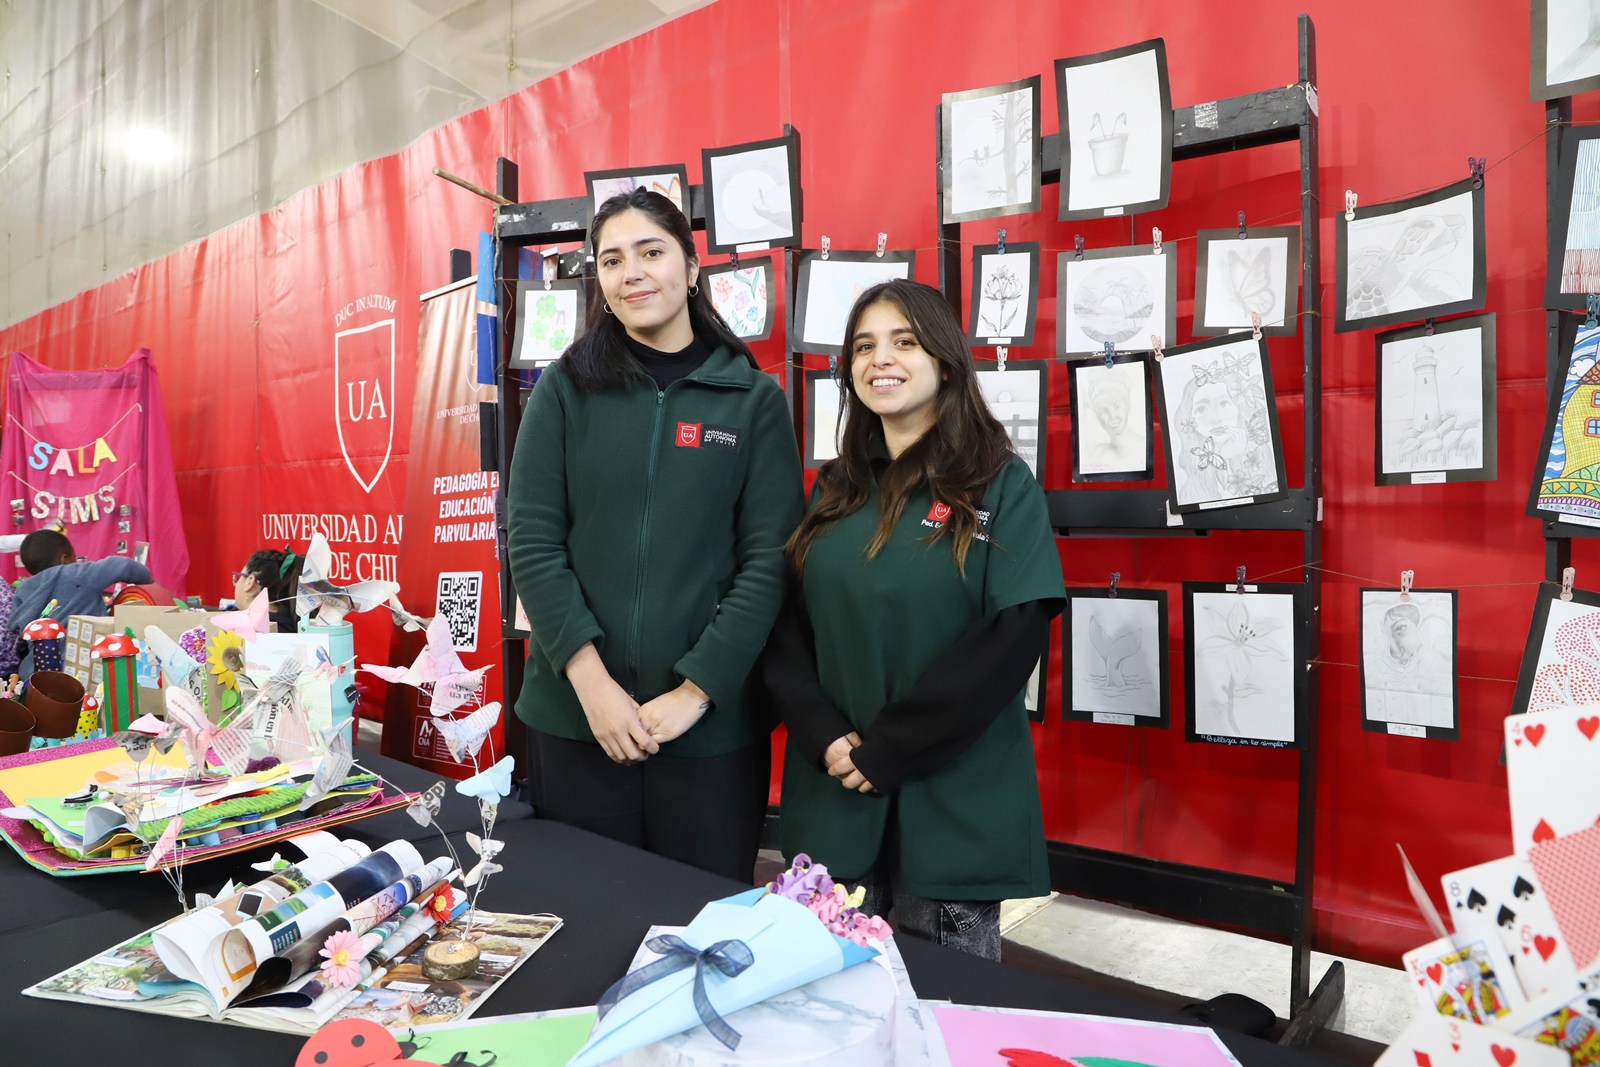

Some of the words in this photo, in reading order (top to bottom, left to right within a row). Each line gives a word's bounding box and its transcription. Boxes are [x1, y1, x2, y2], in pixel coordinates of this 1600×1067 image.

[335, 302, 354, 328] DUC
[366, 294, 397, 313] ALTUM
[346, 378, 388, 422] UA
[437, 403, 478, 419] UNIVERSIDAD
[460, 415, 469, 424] DE
[28, 438, 117, 476] SALA
[31, 485, 116, 524] SIMS
[439, 491, 495, 519] EDUCACIÓN
[262, 514, 378, 543] UNIVERSIDAD
[433, 521, 496, 543] PARVULARIA
[328, 552, 352, 580] DE
[418, 737, 430, 746] CNA
[1450, 881, 1462, 897] 8
[1520, 924, 1533, 942] 6
[1410, 958, 1423, 976] K
[1450, 1022, 1462, 1040] 3
